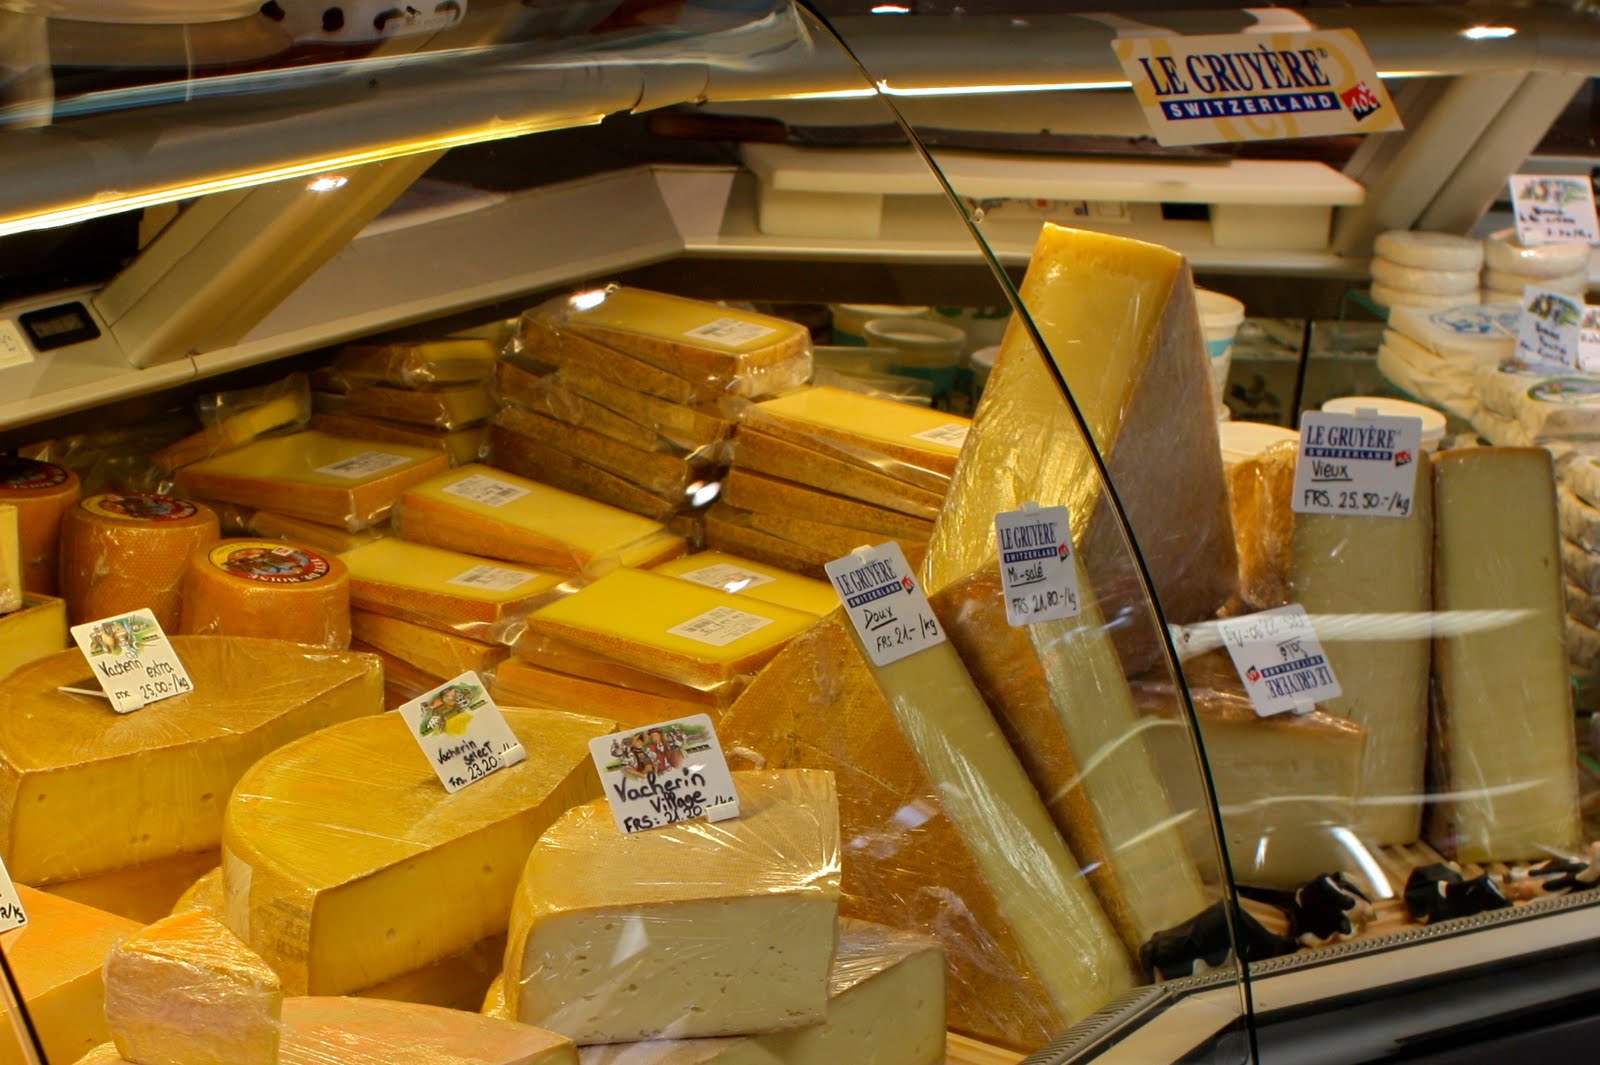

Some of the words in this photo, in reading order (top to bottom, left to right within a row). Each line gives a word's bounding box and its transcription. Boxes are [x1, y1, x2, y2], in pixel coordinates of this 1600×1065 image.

[1139, 56, 1189, 96] LE
[1170, 94, 1333, 118] SWITZERLAND
[1306, 425, 1325, 446] LE
[1000, 528, 1013, 550] LE
[1005, 547, 1057, 562] SWITZERLAND
[836, 573, 855, 596] LE
[850, 582, 901, 607] SWITZERLAND
[864, 606, 894, 630] Doux
[1314, 665, 1334, 686] LE
[613, 767, 706, 803] Vacherin
